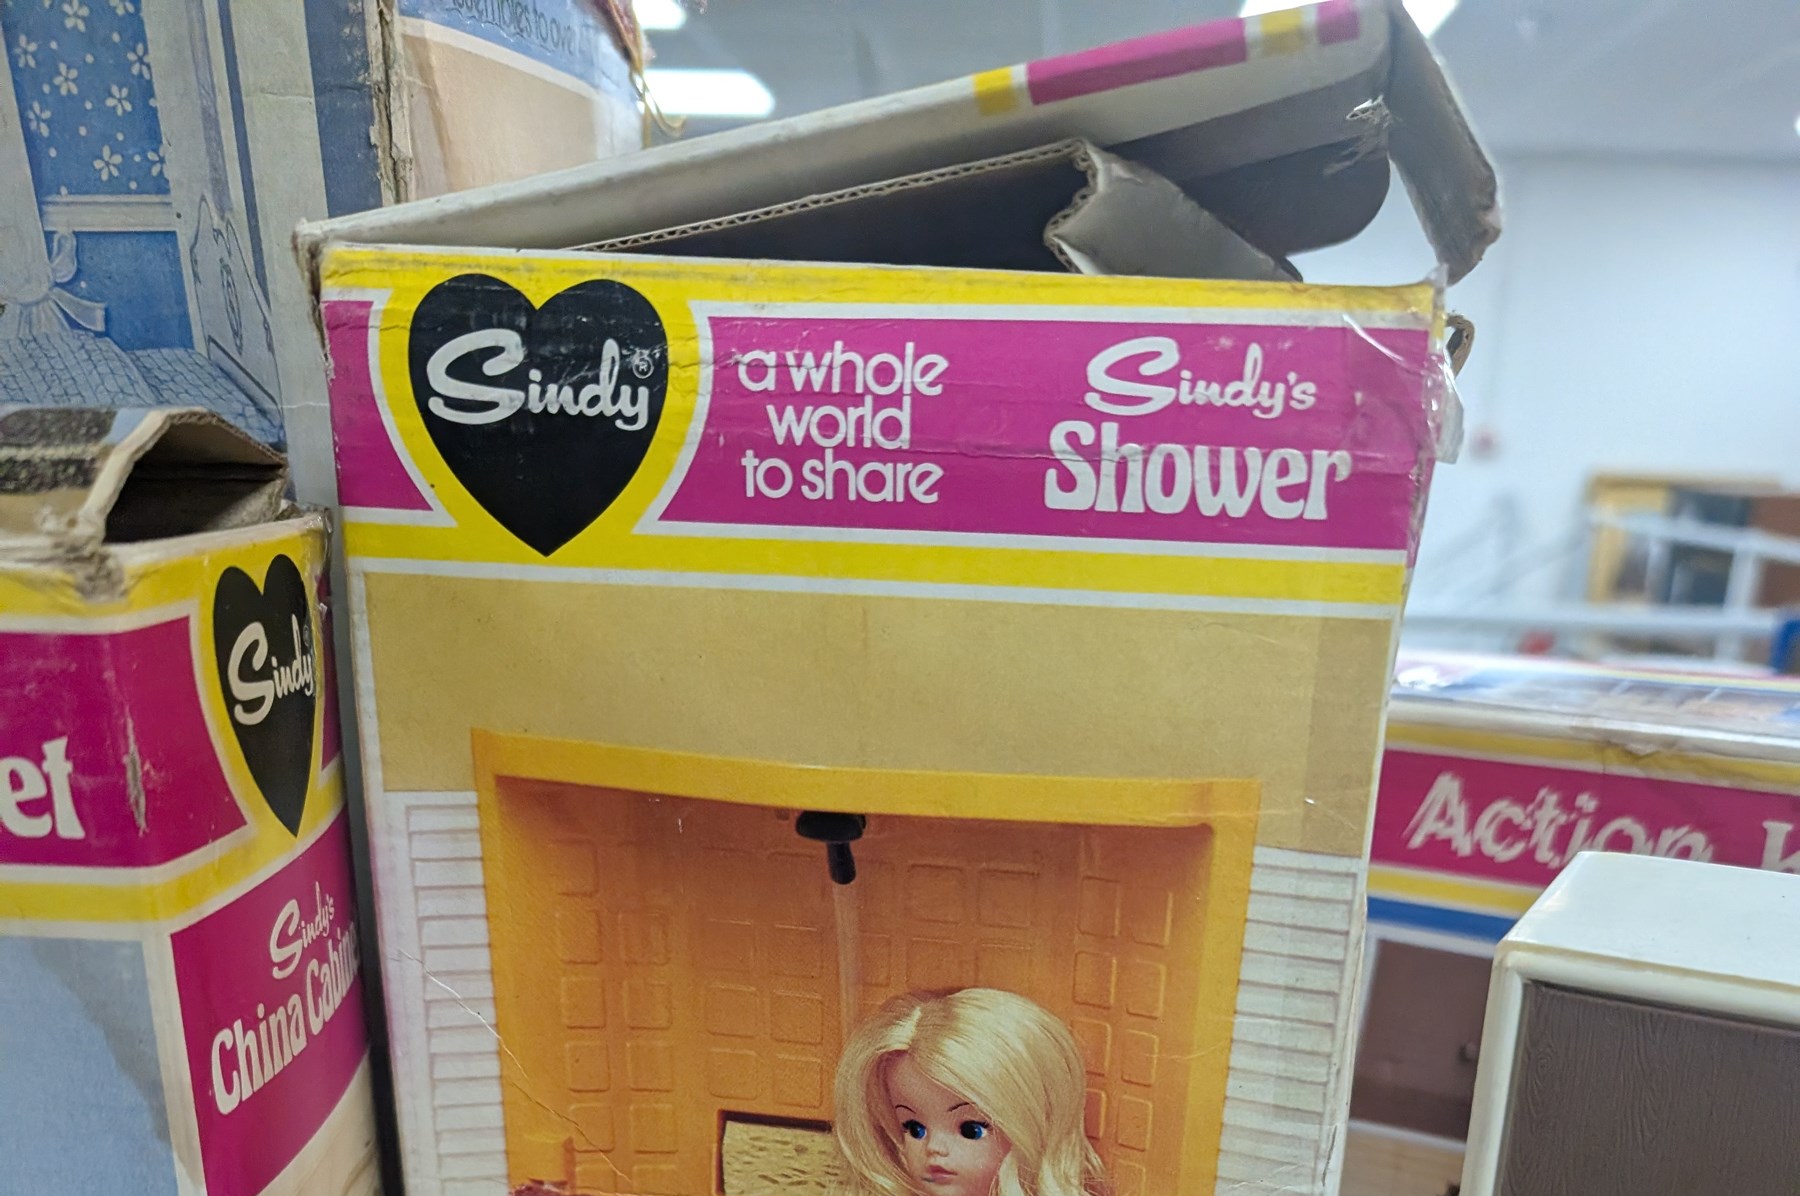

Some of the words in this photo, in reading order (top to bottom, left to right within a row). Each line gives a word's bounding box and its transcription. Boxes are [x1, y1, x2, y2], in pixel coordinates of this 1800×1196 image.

[426, 328, 650, 432] Sindy
[737, 351, 776, 392] a
[786, 339, 949, 397] whole
[1084, 336, 1318, 420] Sindy's
[766, 397, 911, 451] world
[1044, 420, 1352, 522] Shower
[740, 448, 793, 500] to
[800, 447, 944, 504] share
[227, 612, 314, 726] Sindy
[1403, 771, 1714, 870] Action
[269, 880, 335, 980] Sindy's
[211, 993, 308, 1116] China
[306, 920, 361, 1036] Cabine
